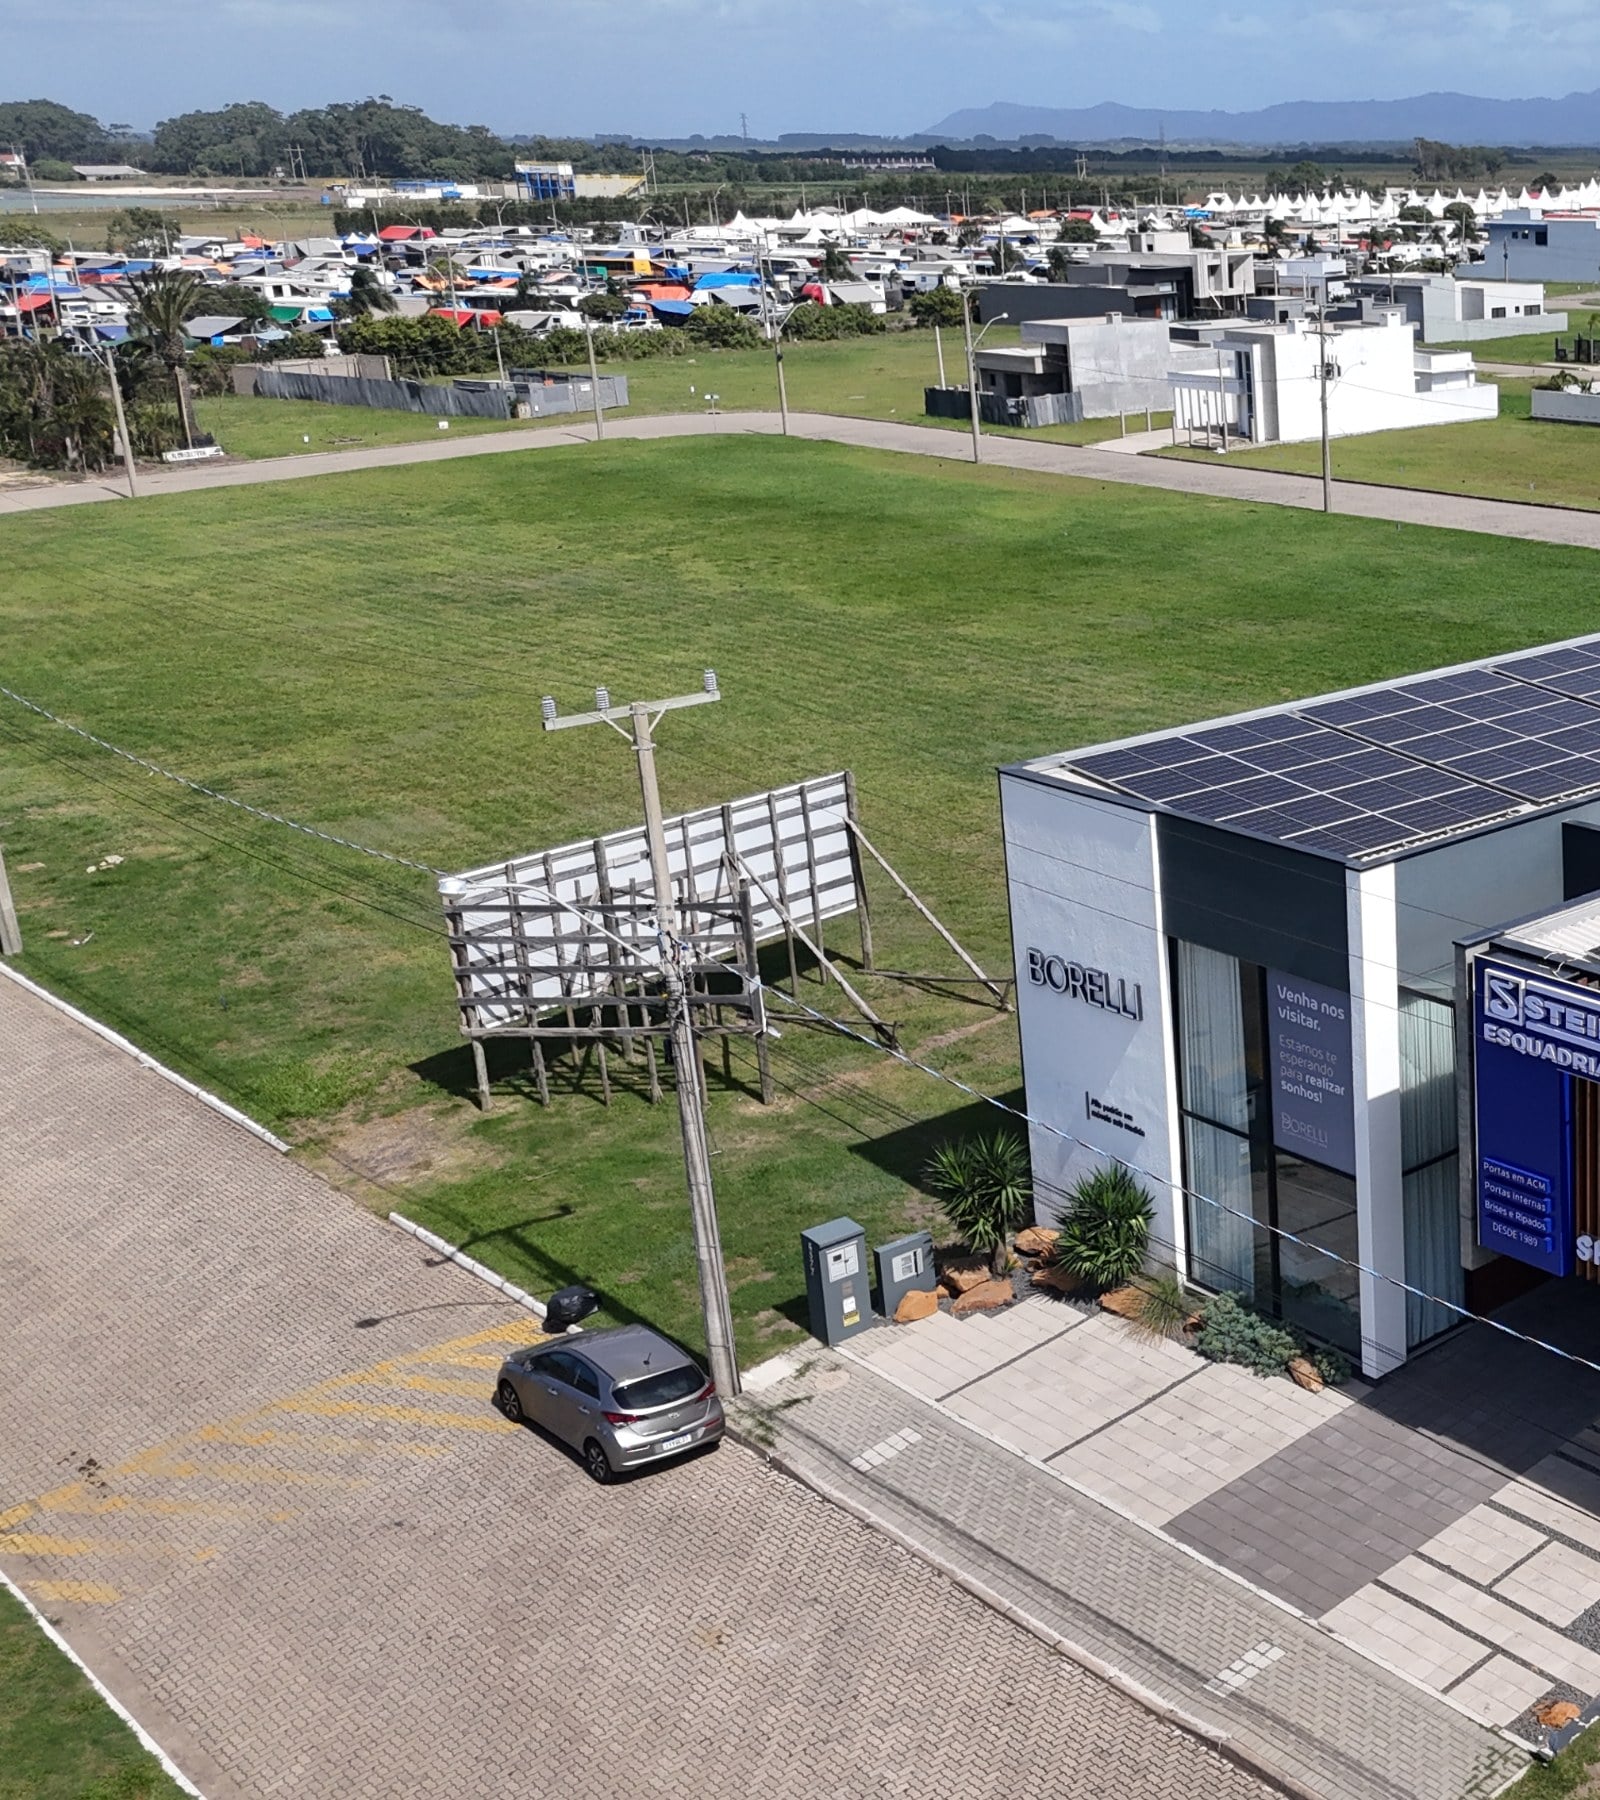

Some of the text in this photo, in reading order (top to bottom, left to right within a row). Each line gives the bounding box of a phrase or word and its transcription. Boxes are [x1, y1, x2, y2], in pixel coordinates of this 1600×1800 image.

[1026, 947, 1143, 1022] BORELLI
[1277, 984, 1345, 1021] Venha nos
[1278, 1006, 1321, 1031] visitar.
[1279, 1034, 1337, 1065] Estamos te
[1280, 1051, 1334, 1078] esperando
[1280, 1066, 1345, 1096] para realizar
[1281, 1080, 1323, 1103] sonhos!
[1281, 1112, 1328, 1143] BORELLI
[1483, 1161, 1546, 1191] Portas em ACM
[1484, 1181, 1511, 1199] Portas
[1484, 1200, 1546, 1231] Brises e Ripados
[1492, 1222, 1538, 1247] DESDE 1989
